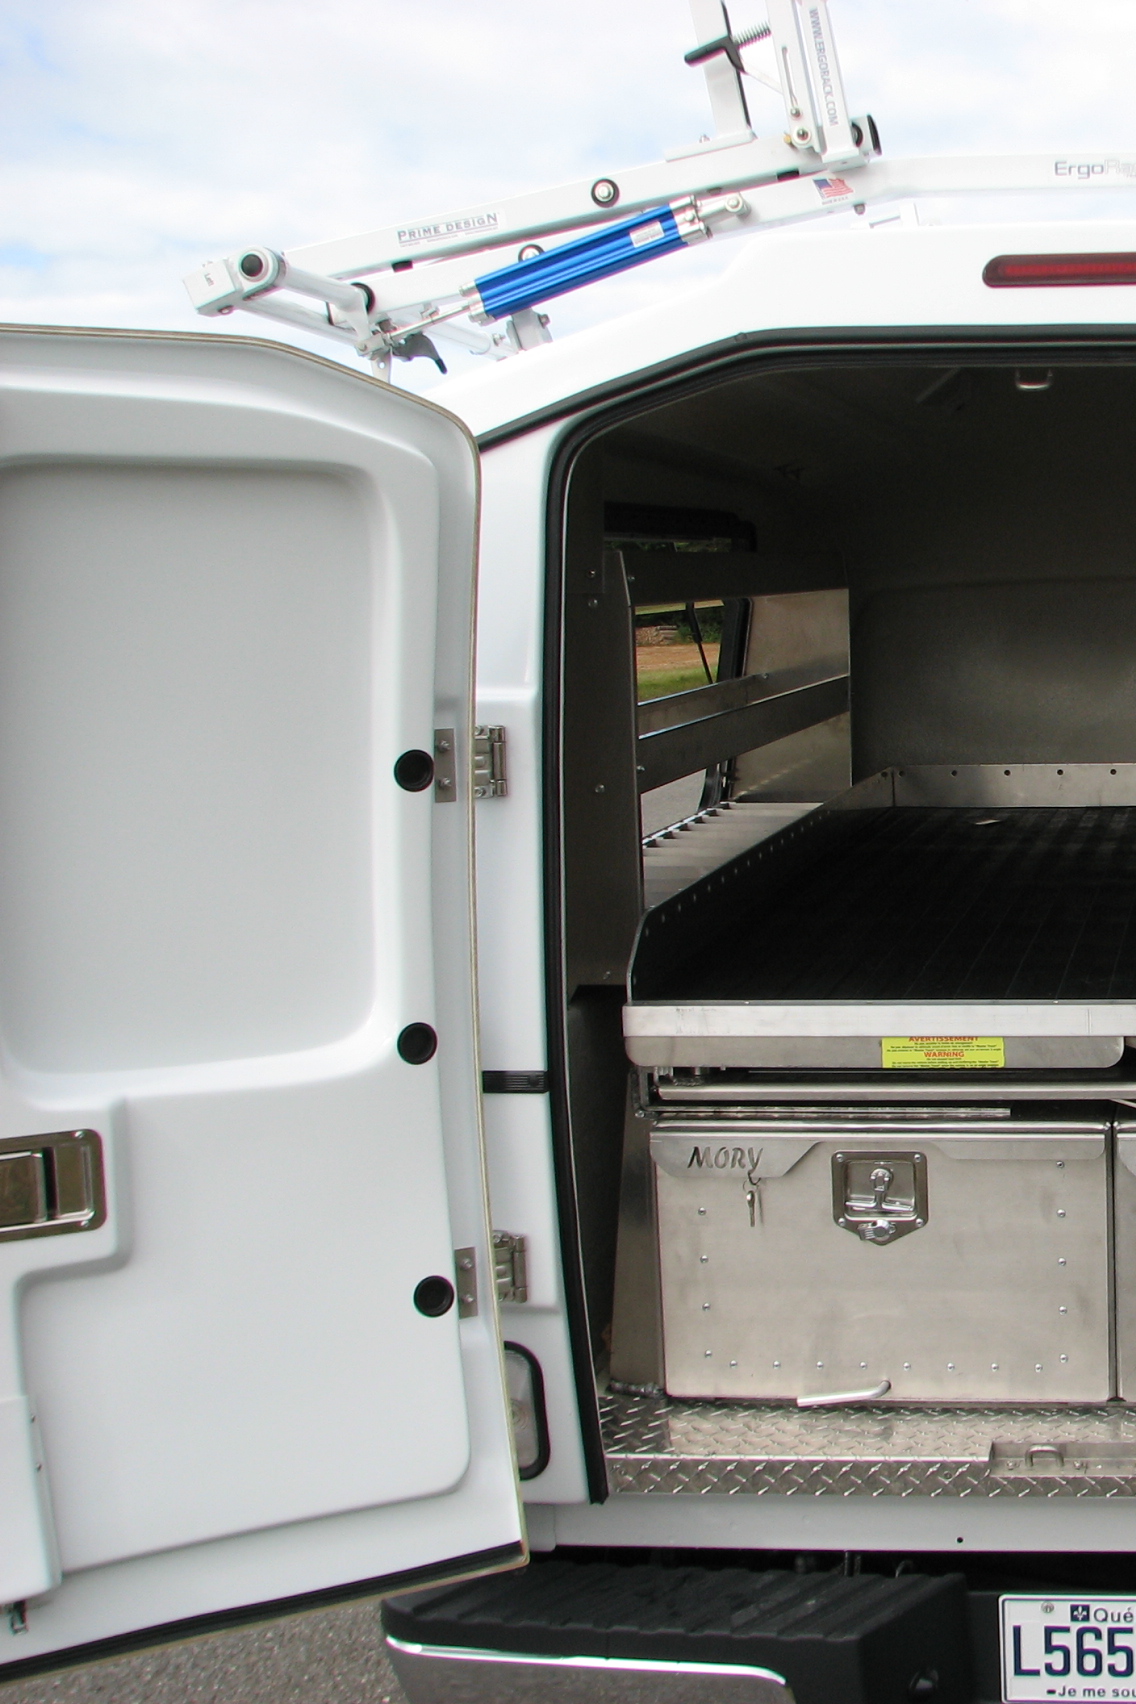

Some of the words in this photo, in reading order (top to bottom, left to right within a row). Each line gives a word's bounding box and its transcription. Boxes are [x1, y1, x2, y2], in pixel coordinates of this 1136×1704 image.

[808, 7, 840, 126] WWW.ERGORACK.COM
[397, 225, 441, 241] PRIME
[446, 212, 499, 232] DESIGN
[687, 1146, 764, 1175] MORY
[1058, 1685, 1076, 1697] Je
[1082, 1688, 1106, 1697] me
